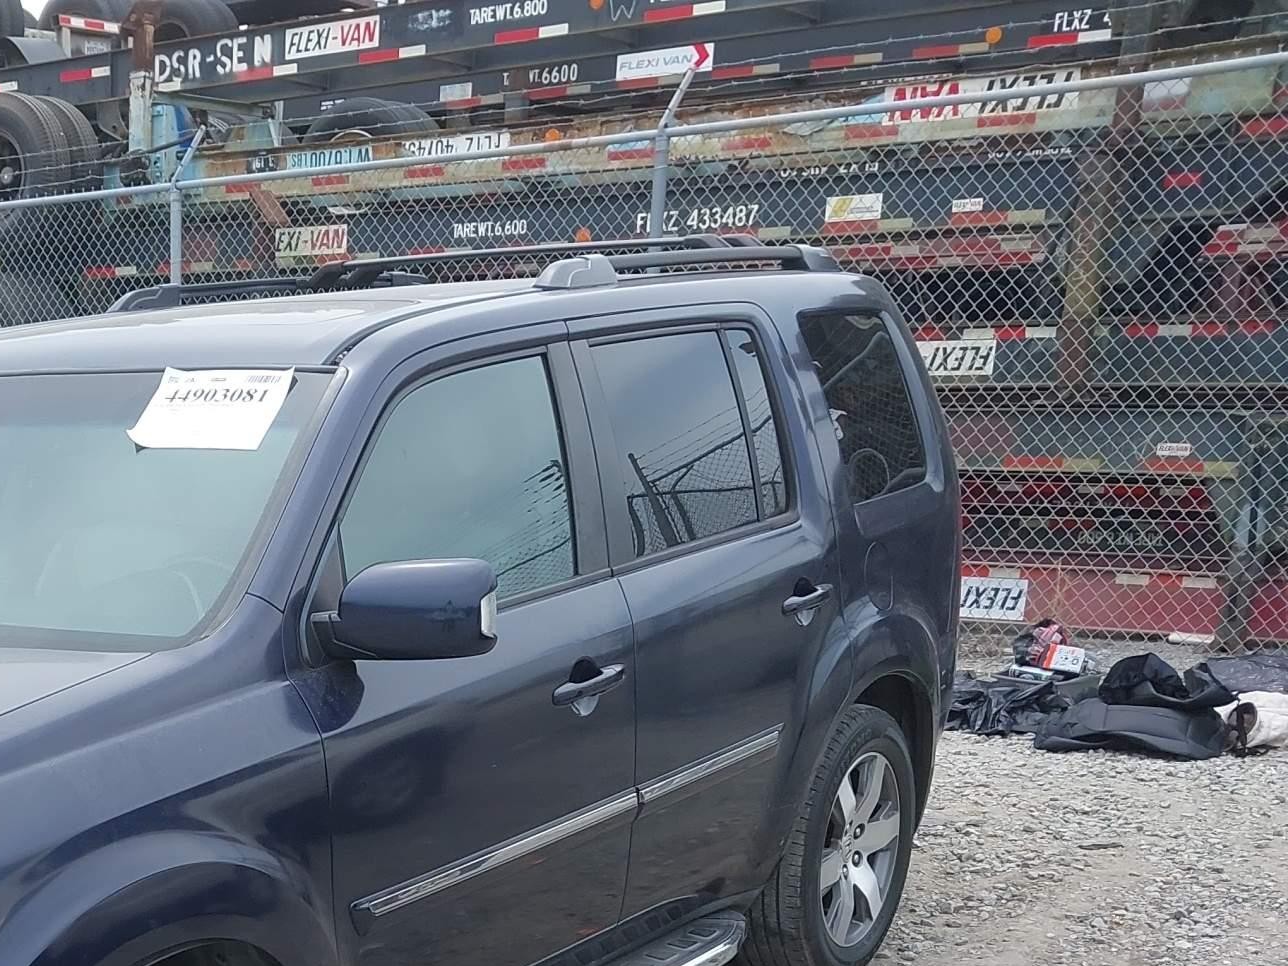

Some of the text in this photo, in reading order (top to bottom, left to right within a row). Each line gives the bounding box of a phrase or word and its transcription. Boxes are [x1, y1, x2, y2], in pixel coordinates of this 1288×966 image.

[1053, 9, 1092, 32] FLXZ
[287, 20, 378, 55] FLEXI-VAN
[619, 52, 694, 71] FLEXI VAN
[686, 203, 760, 230] 433487
[165, 388, 269, 403] 44903081
